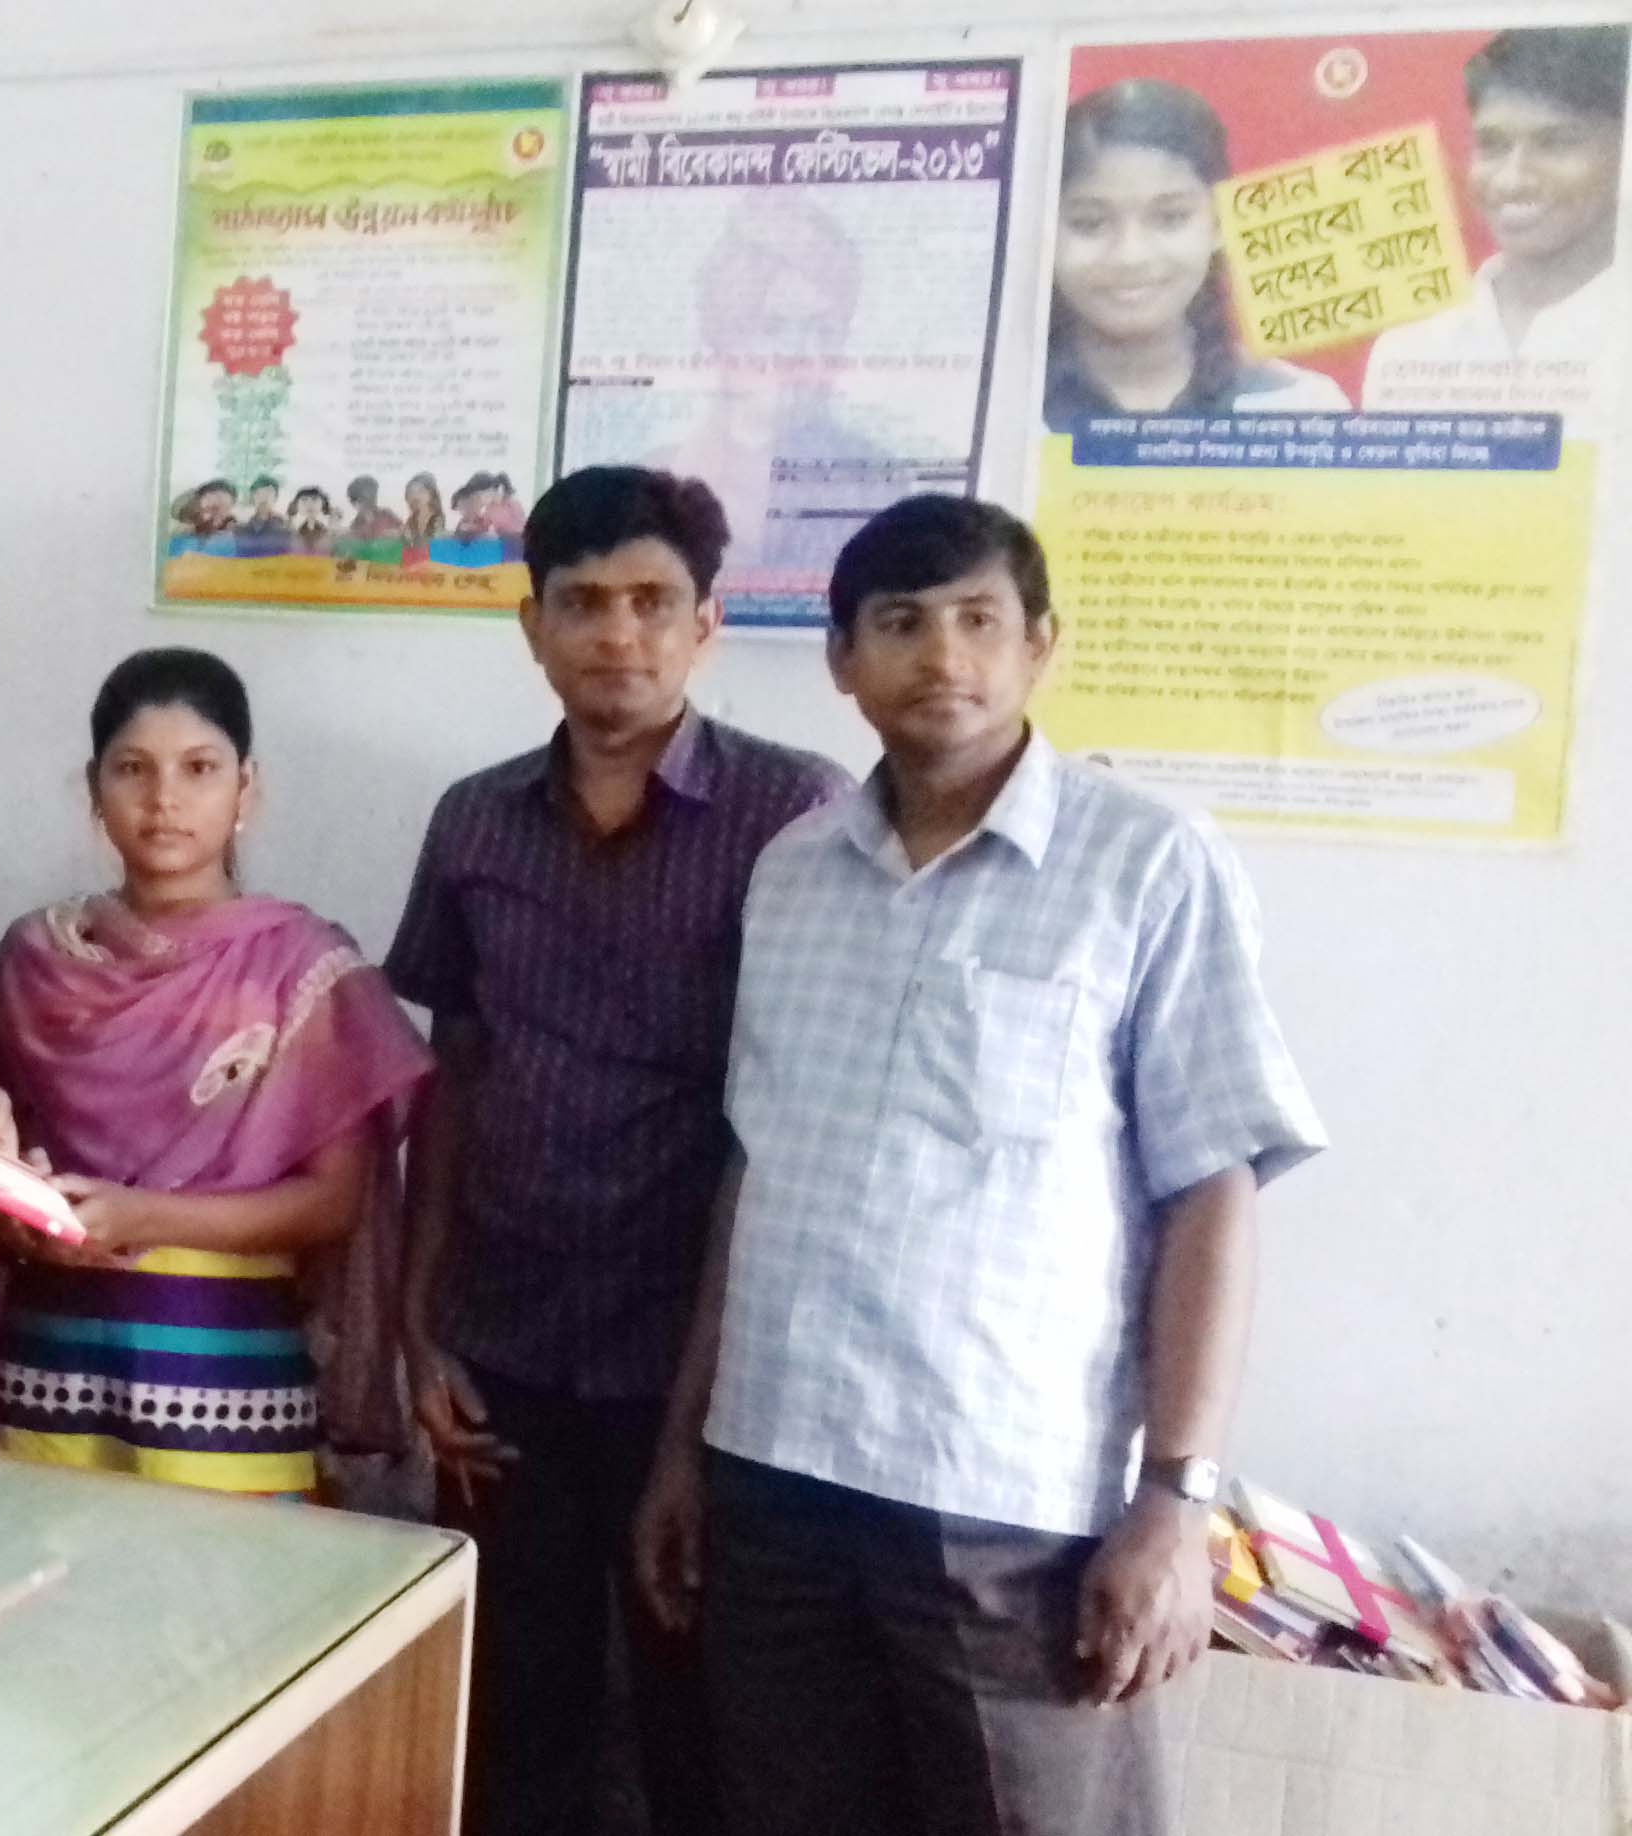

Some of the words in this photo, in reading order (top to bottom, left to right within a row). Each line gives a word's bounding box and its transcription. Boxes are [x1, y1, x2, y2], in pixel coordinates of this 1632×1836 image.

[1233, 166, 1318, 220] কোন
[1342, 136, 1421, 183] বাধা
[1240, 197, 1364, 261] মানবো
[1387, 177, 1431, 218] না
[1250, 252, 1339, 302] দশের
[1358, 223, 1442, 271] আগে
[1260, 285, 1384, 342] থামবো
[1408, 265, 1452, 305] না
